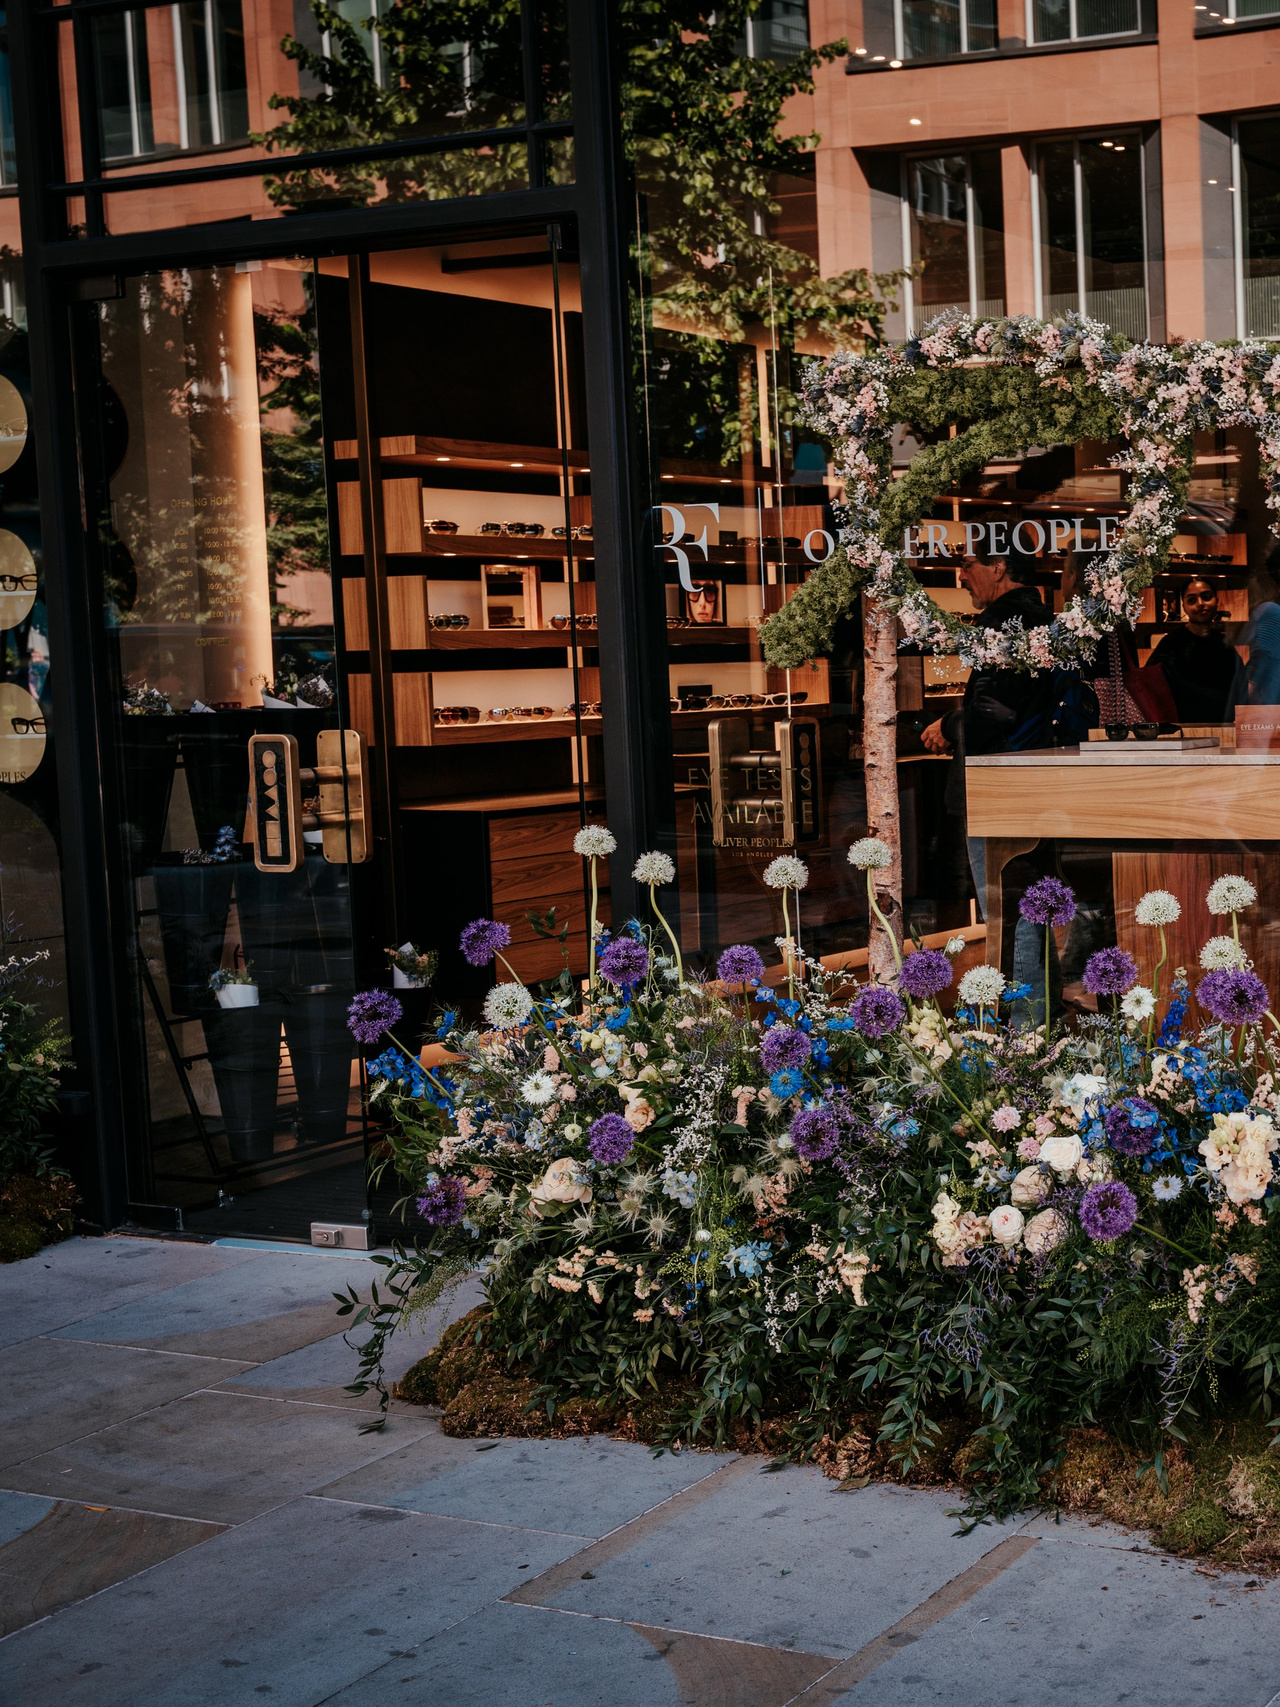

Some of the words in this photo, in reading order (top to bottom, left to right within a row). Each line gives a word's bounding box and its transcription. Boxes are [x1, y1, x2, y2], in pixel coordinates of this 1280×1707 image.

[170, 497, 208, 508] OPENING
[210, 496, 238, 506] HOURS
[174, 528, 189, 536] MON
[803, 524, 952, 563] OER
[963, 516, 1121, 558] PEOPLE
[207, 582, 222, 590] 10:00
[179, 597, 189, 605] SAT
[208, 596, 223, 604] 10:00
[1253, 723, 1275, 731] EXAMS
[689, 768, 729, 791] EYE
[741, 768, 812, 791] TESTS
[691, 801, 813, 824] AVAILABLE
[712, 837, 749, 848] OLIVER
[751, 837, 794, 848] PEOPLES
